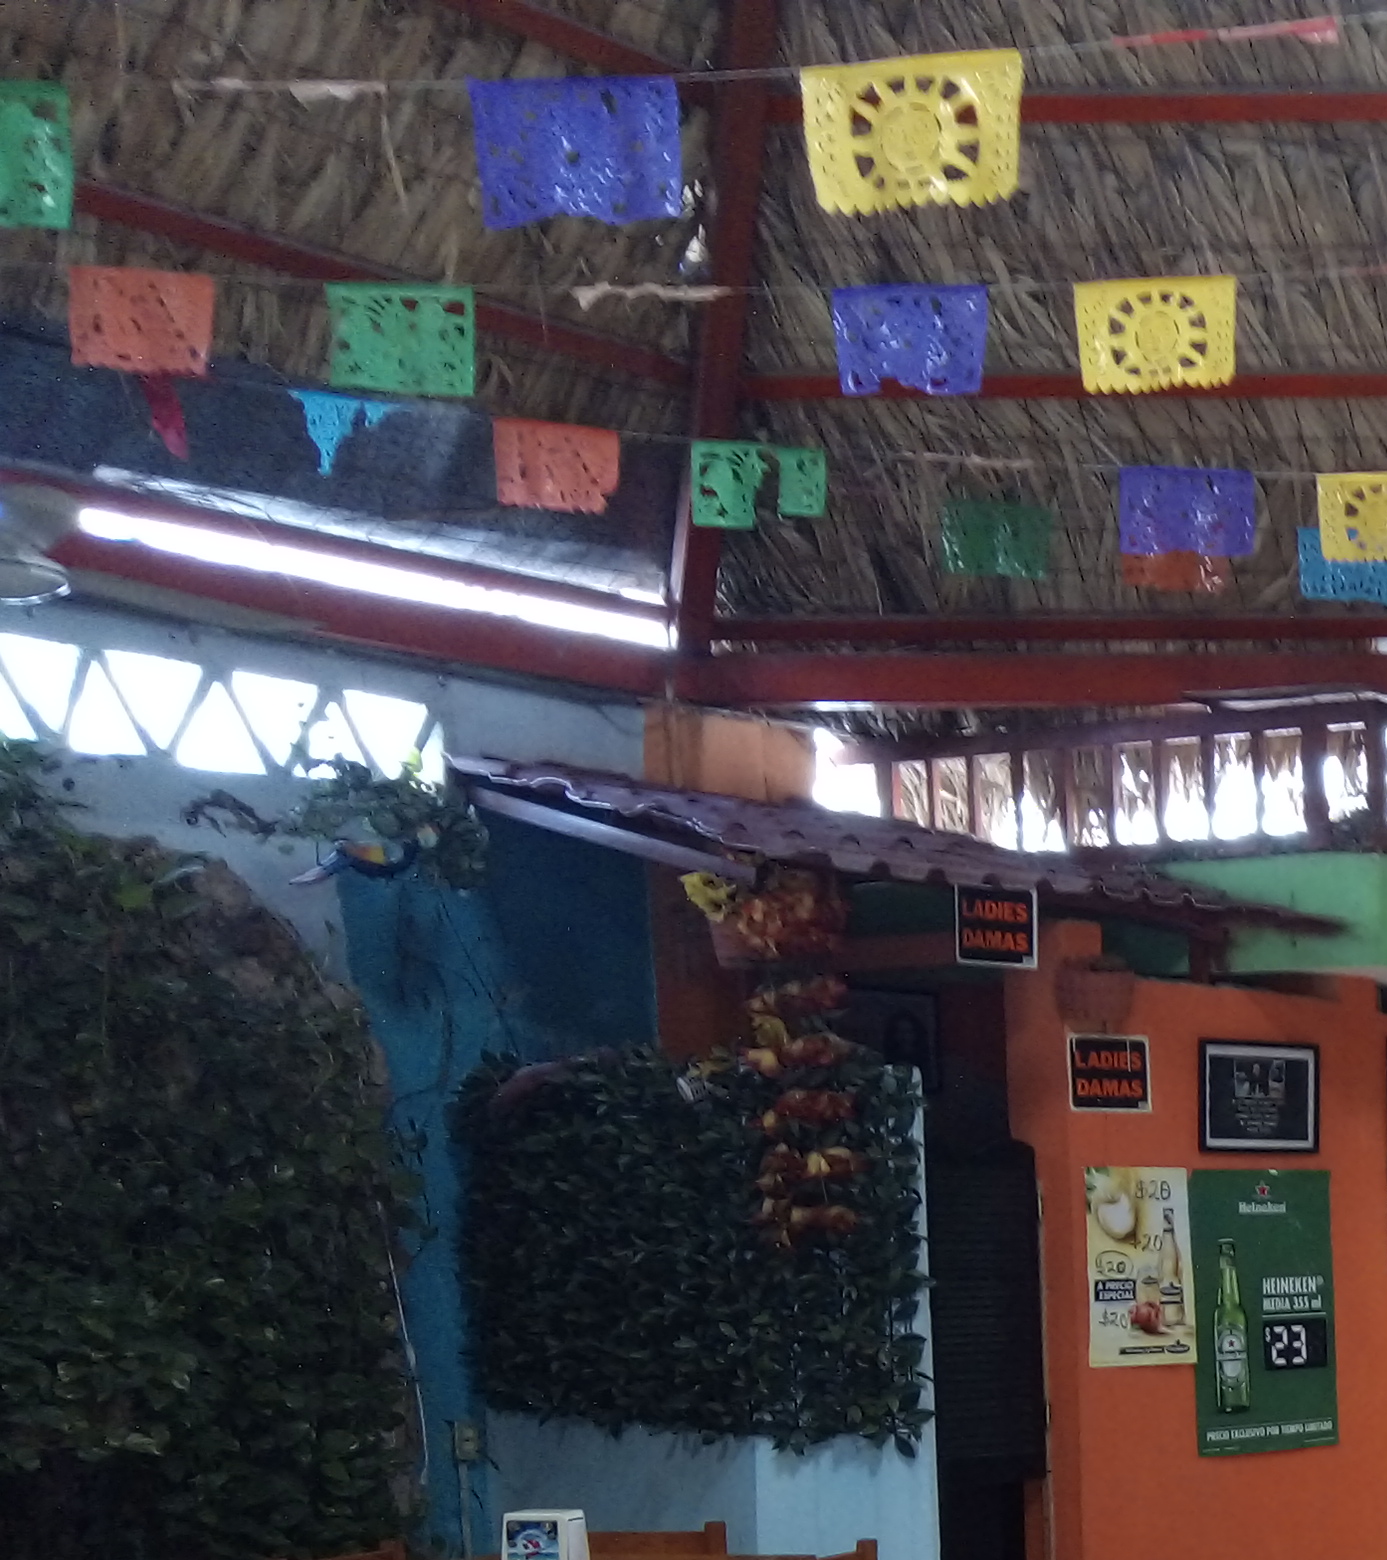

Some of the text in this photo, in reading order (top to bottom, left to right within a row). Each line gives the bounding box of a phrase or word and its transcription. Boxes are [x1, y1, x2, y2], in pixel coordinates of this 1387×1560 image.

[961, 899, 1028, 923] LADIES
[963, 929, 1029, 953] DAMAS
[1075, 1051, 1142, 1070] LADIES
[1077, 1079, 1143, 1098] DAMAS
[1239, 1202, 1286, 1214] Heineken
[1263, 1295, 1322, 1311] MEDIA 355 ml
[1207, 1431, 1230, 1441] PRECIO
[1231, 1427, 1265, 1439] EXCLUSIVO
[1266, 1426, 1280, 1436] POR
[1281, 1424, 1304, 1435] TIEMPO
